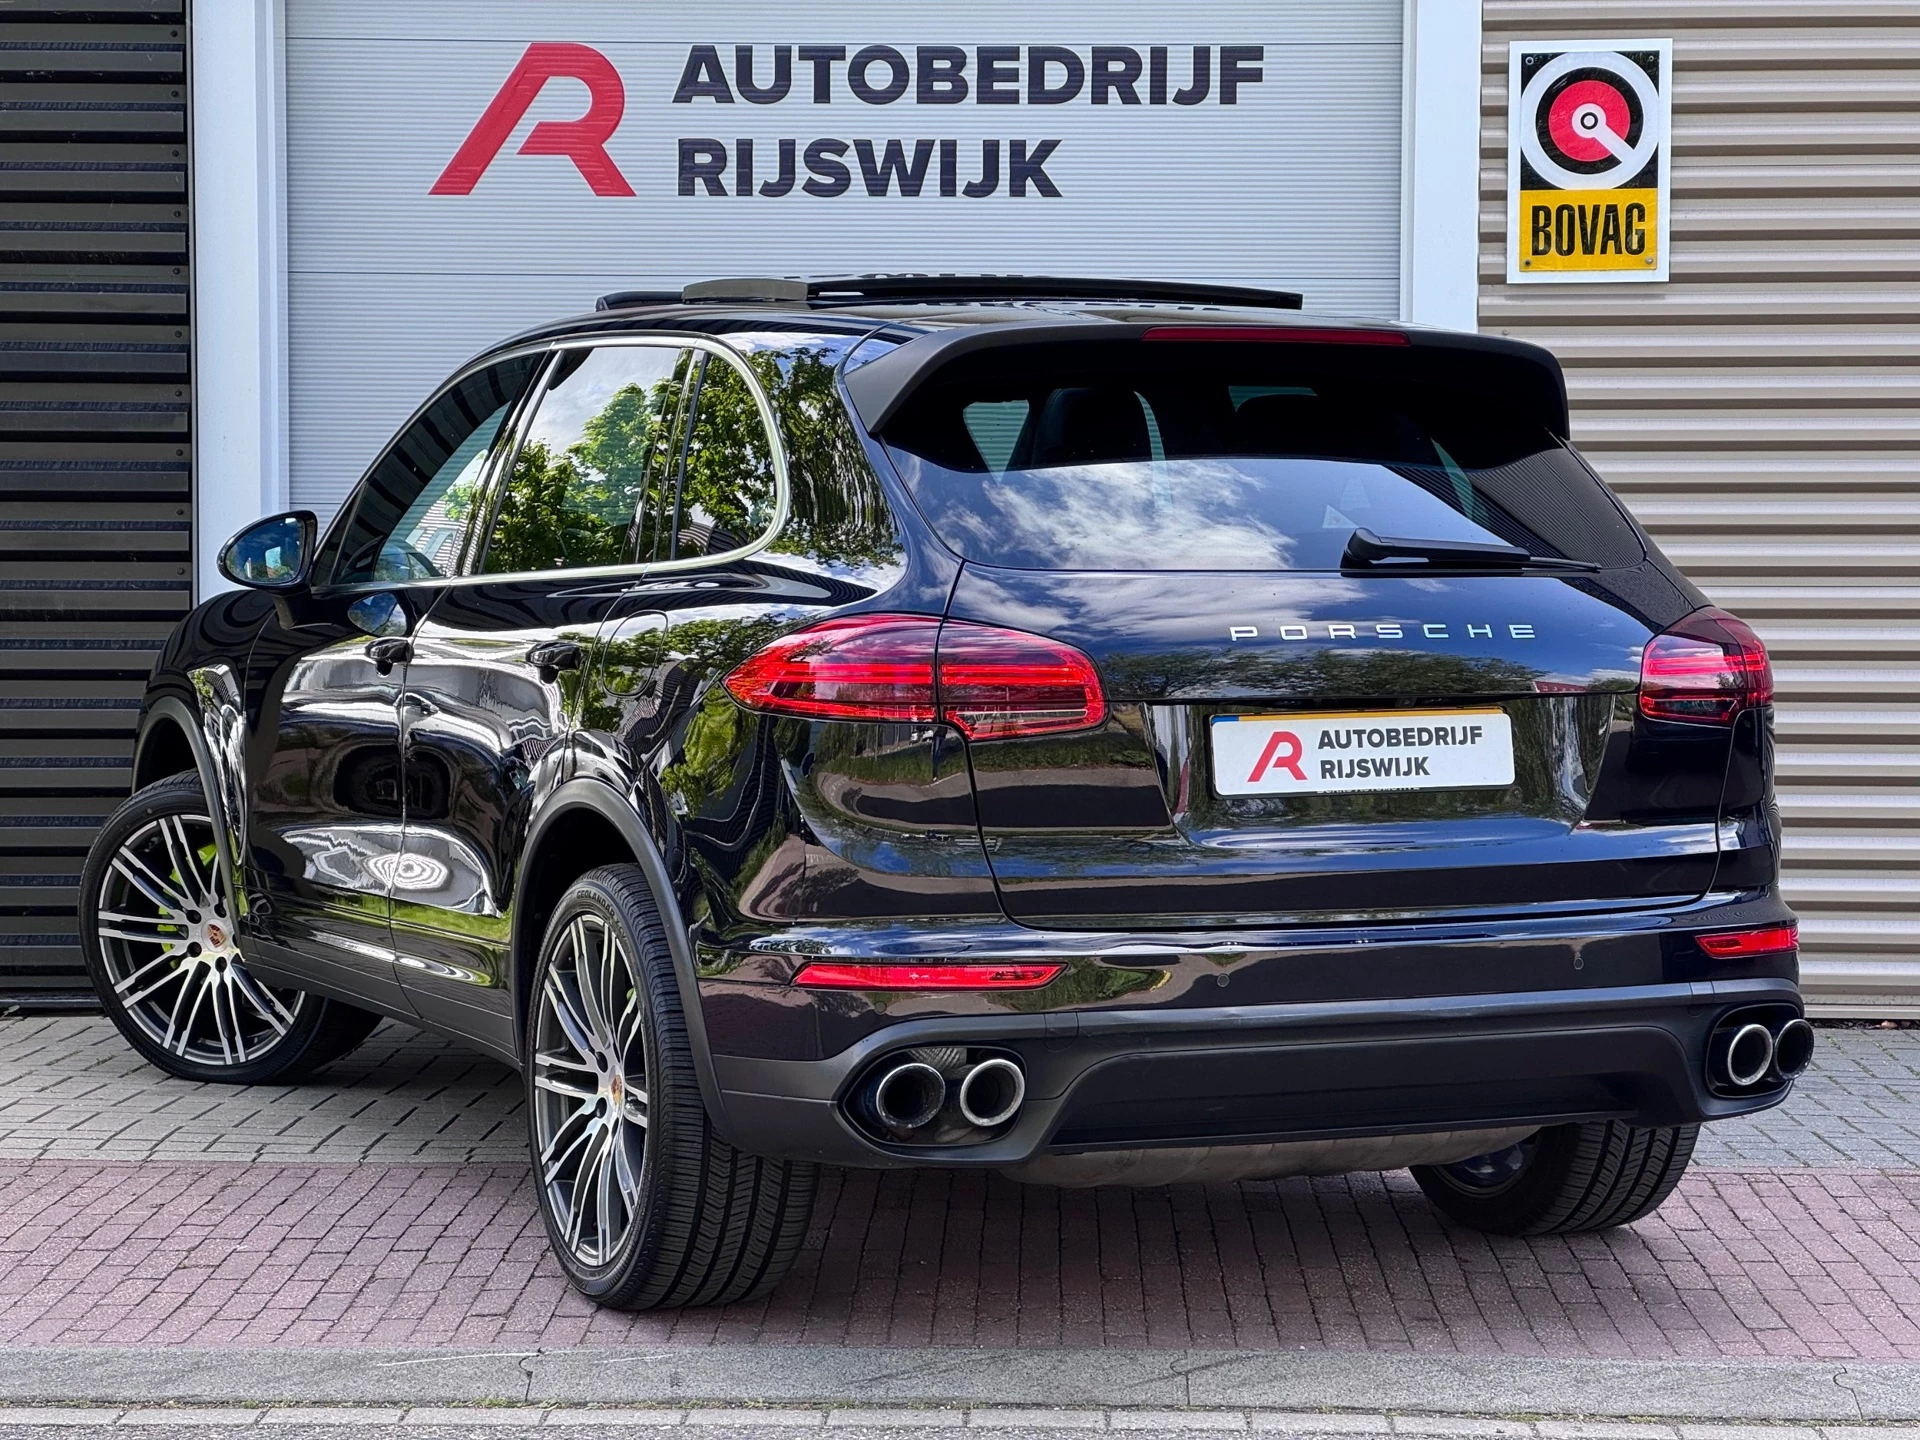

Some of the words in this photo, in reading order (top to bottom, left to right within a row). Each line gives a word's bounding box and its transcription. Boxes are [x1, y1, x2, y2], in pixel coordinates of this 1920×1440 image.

[672, 44, 1263, 105] AUTOBEDRIJF
[678, 139, 1062, 198] RIJSWIJK
[1532, 202, 1645, 256] BOVAG
[1230, 623, 1536, 642] PORSCHE
[1318, 726, 1482, 749] AUTOBEDRIJF
[1321, 757, 1430, 779] RIJSWIJK
